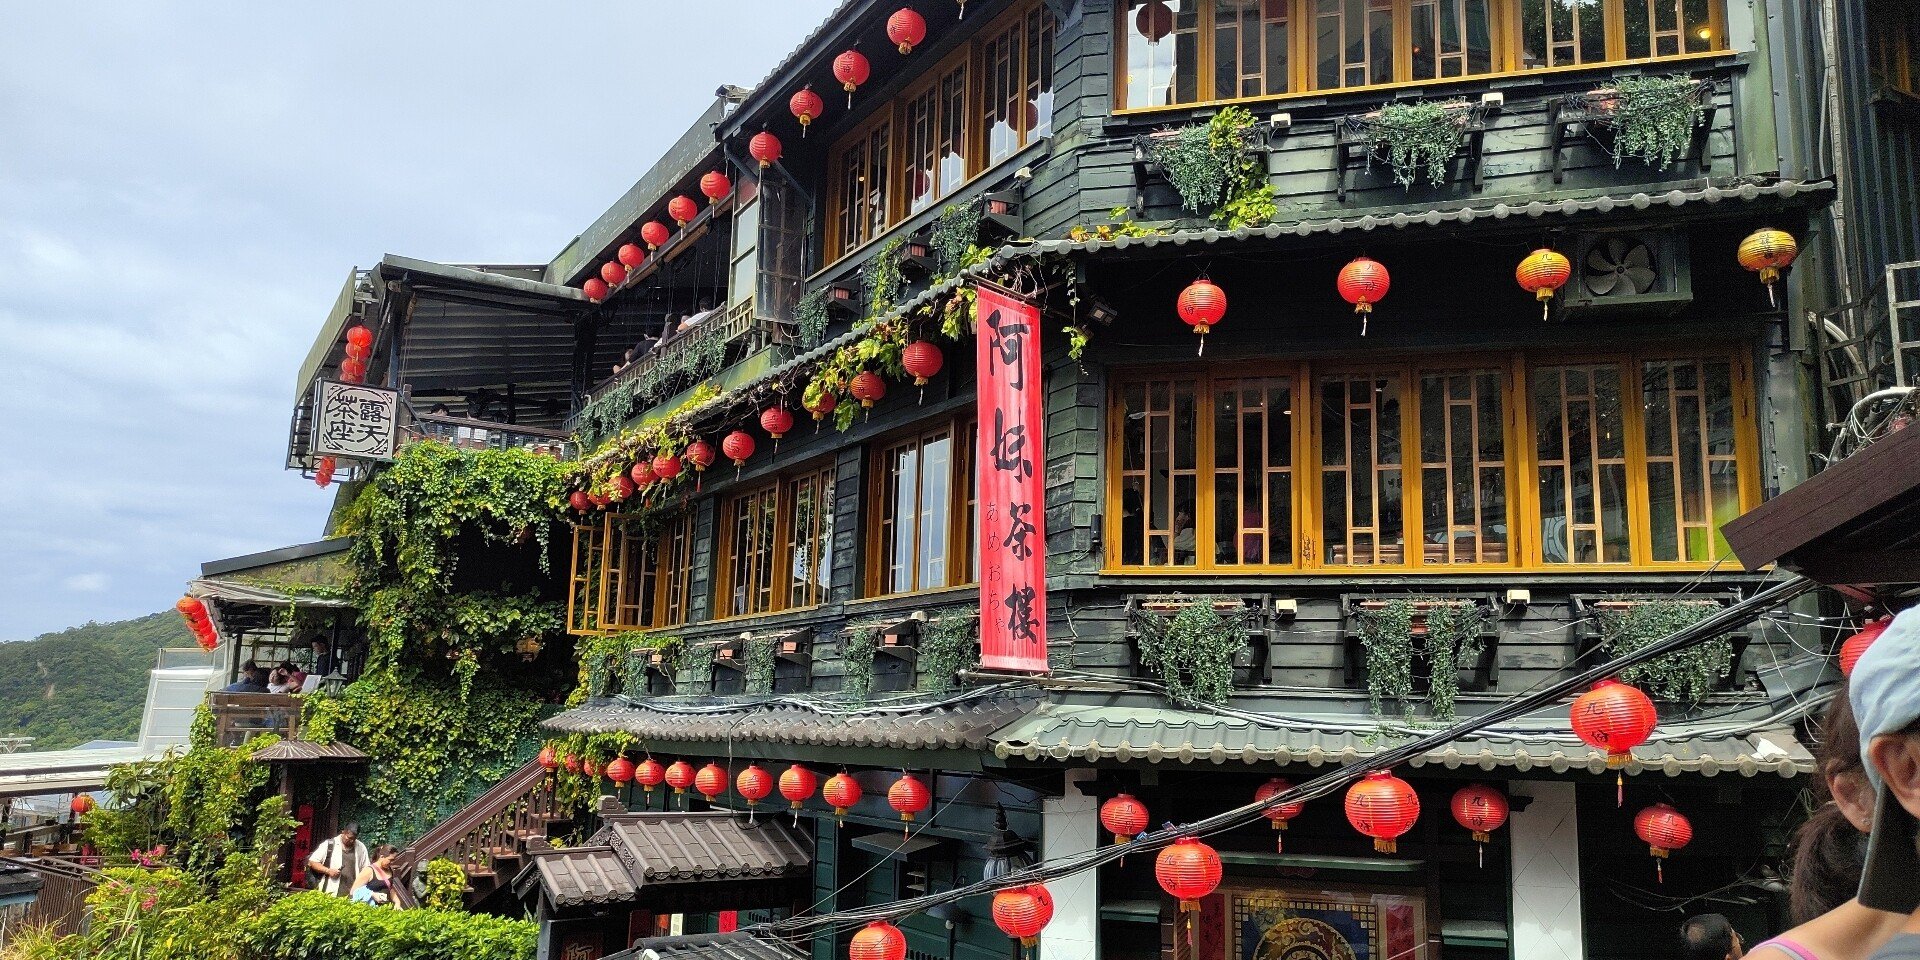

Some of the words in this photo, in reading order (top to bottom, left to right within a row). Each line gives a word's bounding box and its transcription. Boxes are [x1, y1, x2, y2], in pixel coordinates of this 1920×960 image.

[327, 394, 359, 443] 茶座
[356, 398, 391, 443] 露天
[986, 502, 1005, 634] あめおちゃ
[1585, 702, 1609, 743] 九份
[1125, 804, 1136, 830] 九份
[1355, 793, 1372, 832] 九份
[1471, 796, 1484, 827] 九份
[1664, 814, 1678, 844] 九份
[1164, 854, 1177, 890] 九份
